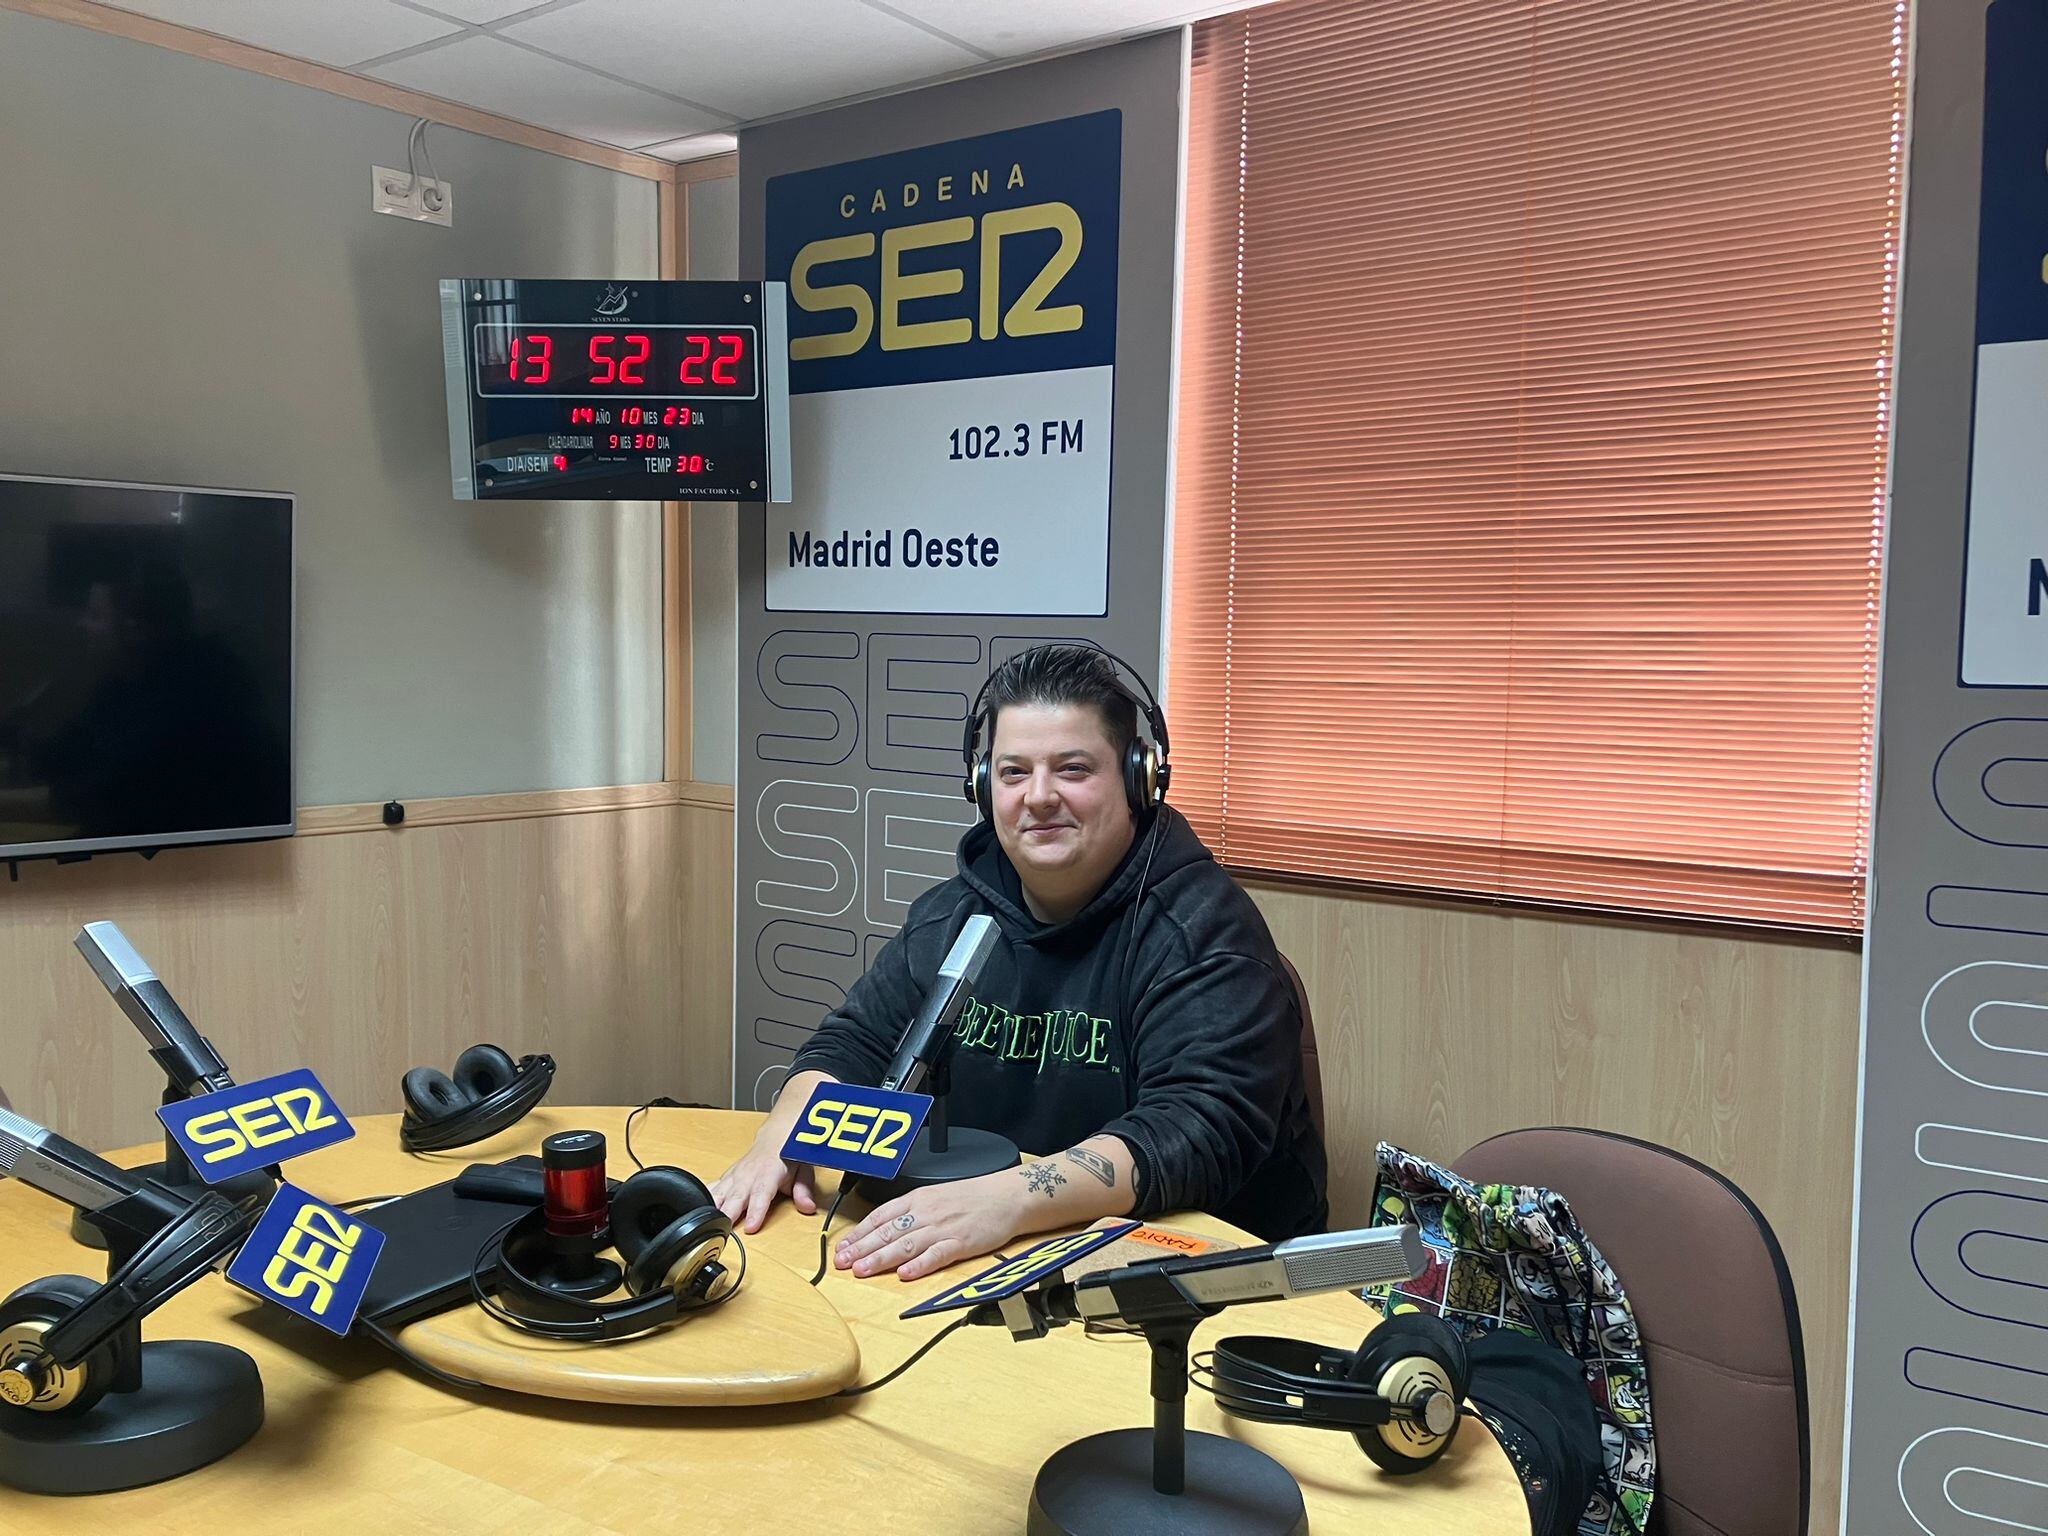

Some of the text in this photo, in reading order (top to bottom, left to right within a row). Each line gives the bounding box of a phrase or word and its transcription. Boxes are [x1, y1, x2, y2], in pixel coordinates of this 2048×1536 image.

[839, 163, 1025, 219] CADENA
[789, 201, 1085, 361] SER
[509, 335, 745, 385] 13 52 22
[571, 406, 705, 426] 14 AÑO 10 MES 23 DIA
[609, 434, 619, 449] 9
[620, 436, 631, 449] MES
[634, 434, 655, 449] 30
[657, 436, 670, 450] DIA
[948, 418, 1084, 461] 102.3 FM
[507, 457, 549, 472] DIA/SEM
[645, 457, 672, 473] TEMP
[676, 455, 703, 473] 30
[788, 528, 1000, 568] Madrid Oeste
[756, 629, 1117, 777] SE
[953, 996, 1112, 1075] BEETLEJUICE
[185, 1087, 337, 1163] SER
[795, 1099, 912, 1159] SER
[261, 1203, 362, 1315] SER
